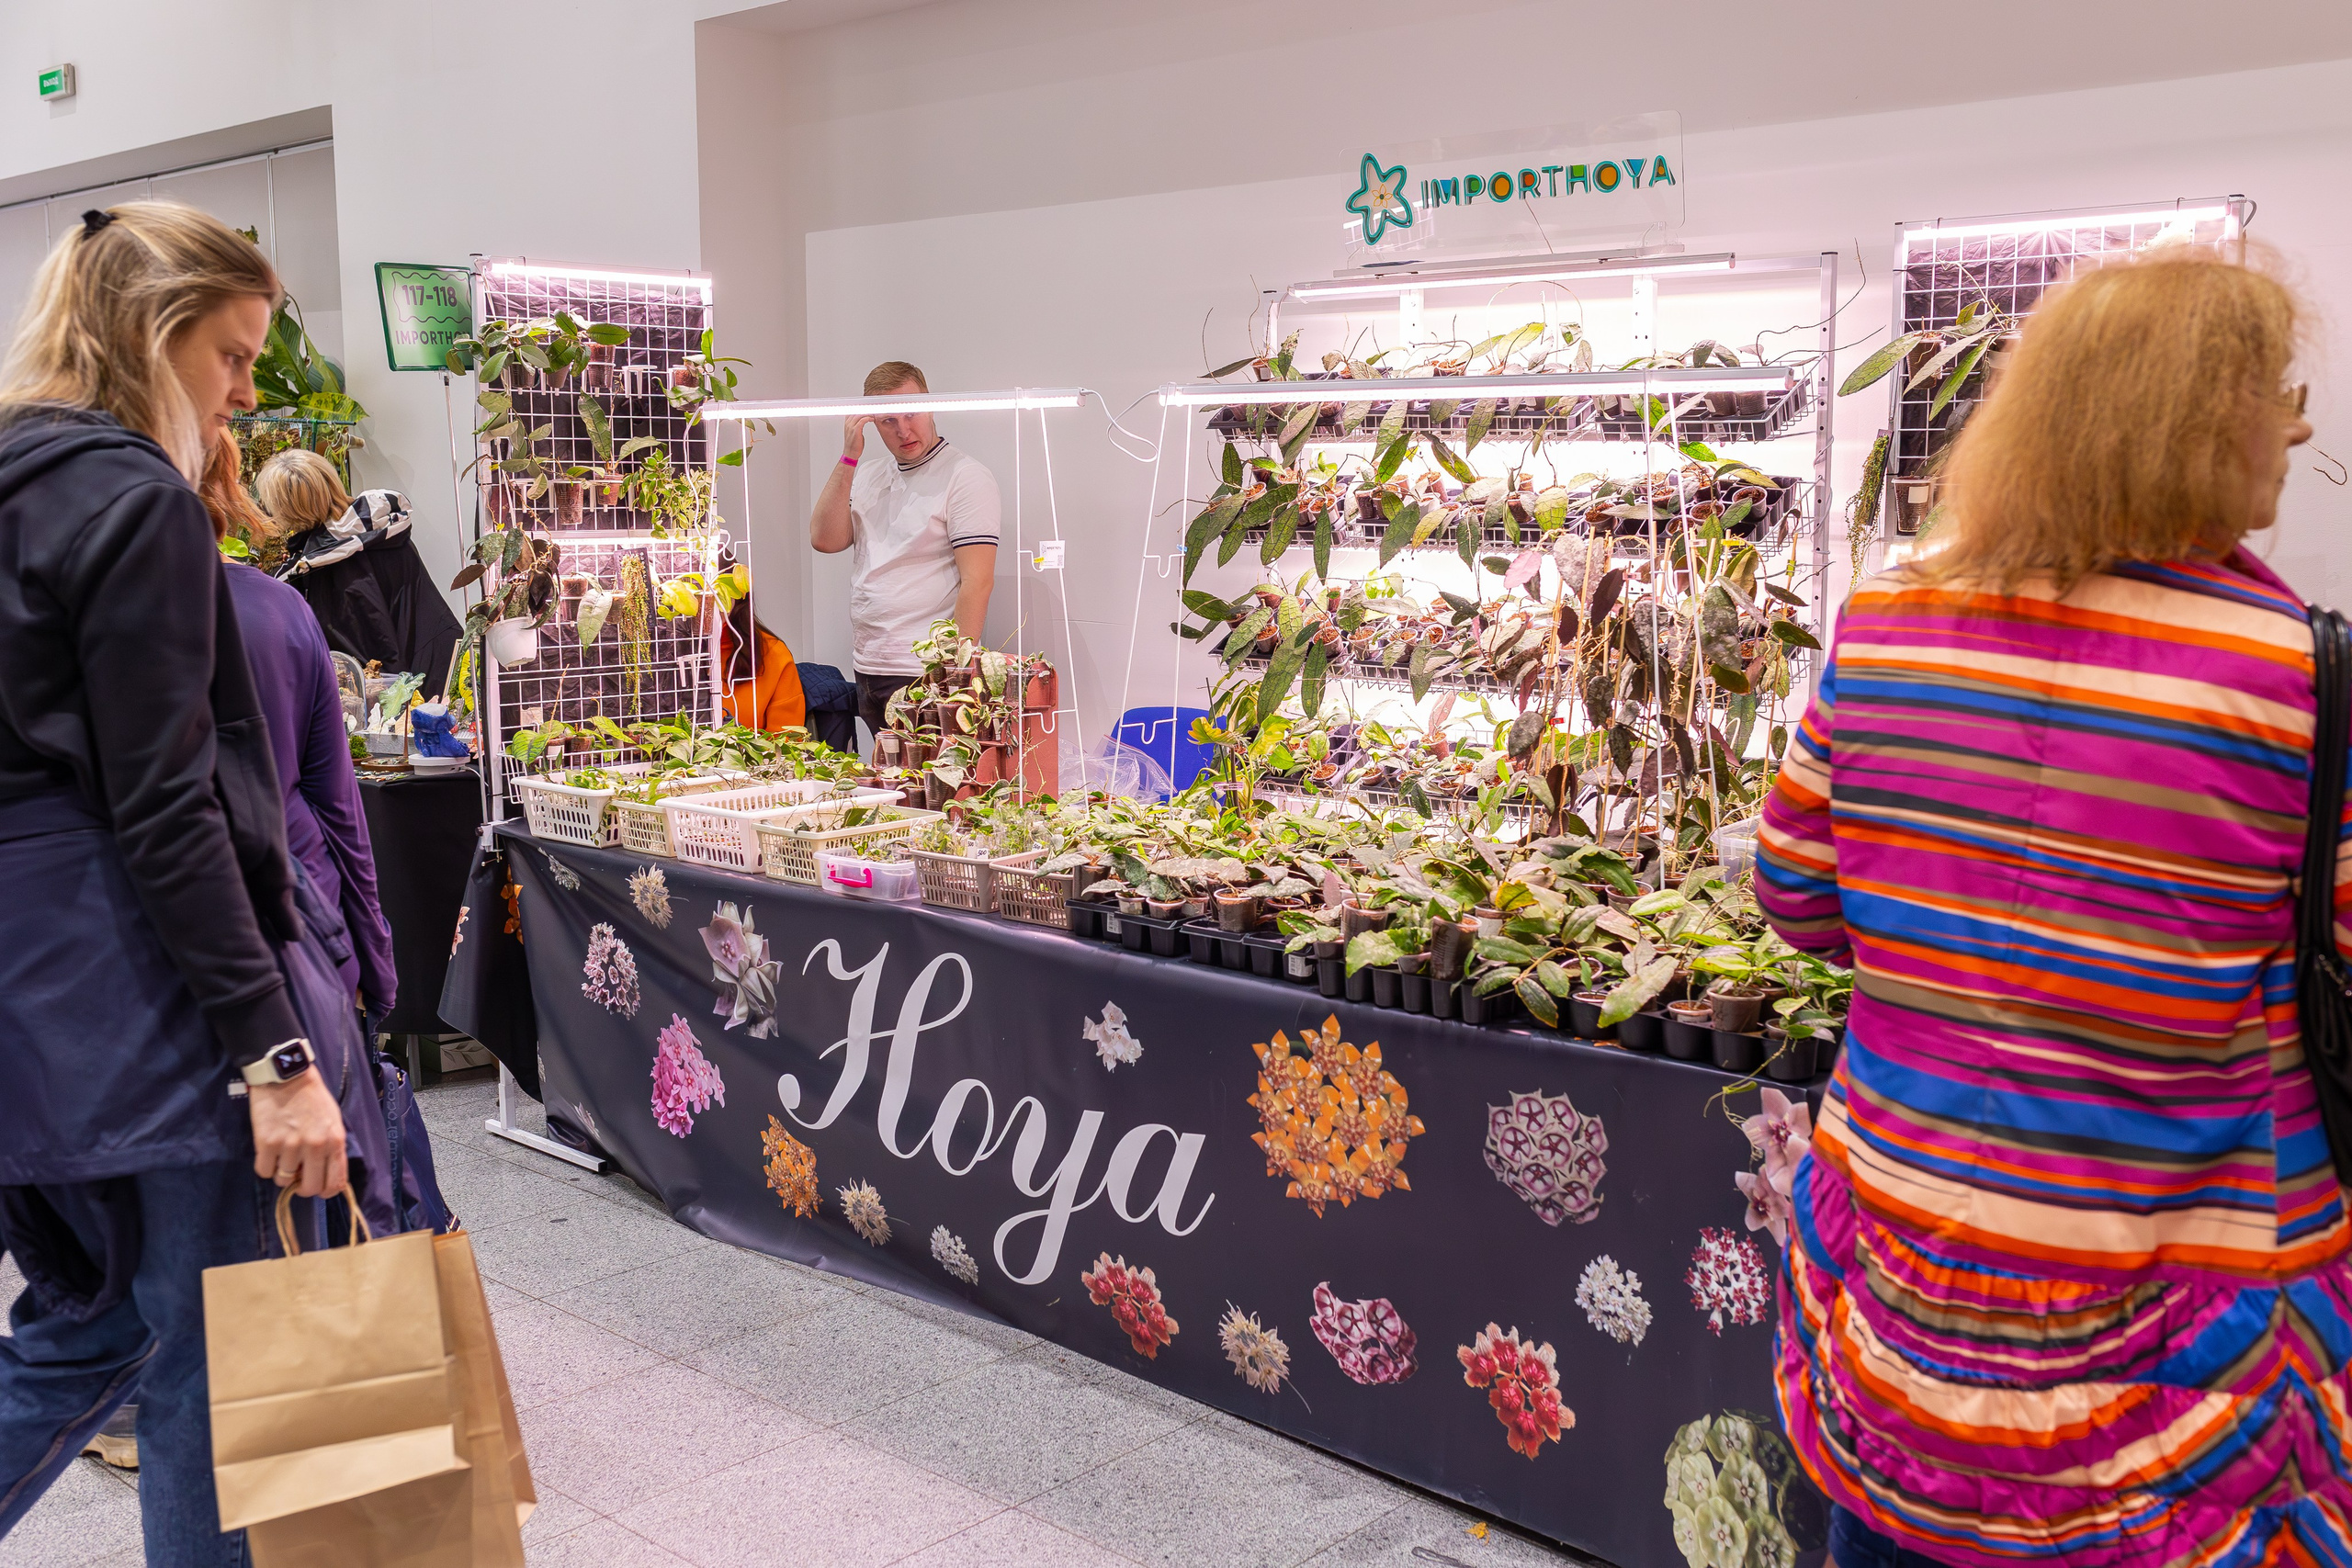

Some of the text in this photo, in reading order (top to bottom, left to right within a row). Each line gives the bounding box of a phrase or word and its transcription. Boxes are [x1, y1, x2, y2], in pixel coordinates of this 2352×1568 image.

[1420, 154, 1677, 209] IMPORTHOYA
[401, 285, 457, 307] 117-118
[777, 939, 1215, 1284] Hoya
